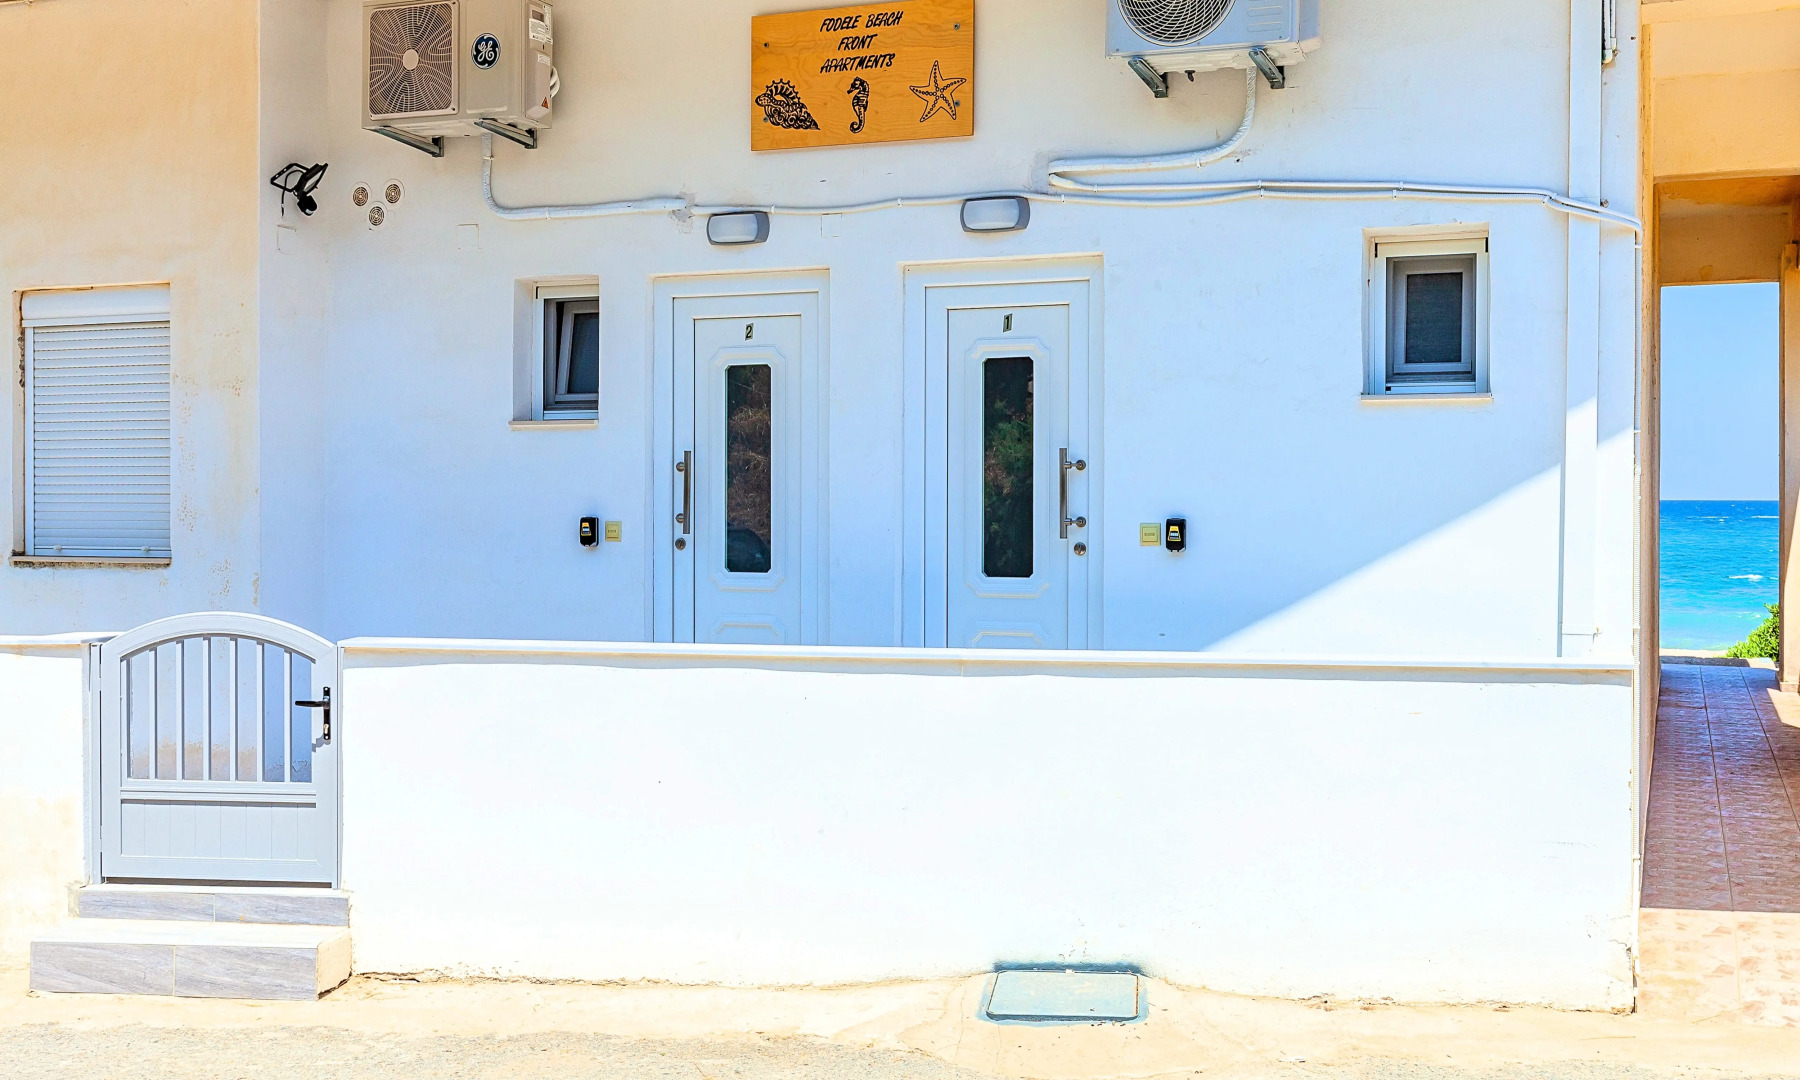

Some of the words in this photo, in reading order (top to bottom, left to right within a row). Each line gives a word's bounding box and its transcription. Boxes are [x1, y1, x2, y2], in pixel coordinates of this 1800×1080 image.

[820, 15, 862, 32] FODELE
[865, 11, 904, 28] BEACH
[838, 34, 878, 51] FRONT
[820, 53, 895, 73] APARTMENTS
[745, 324, 753, 339] 2
